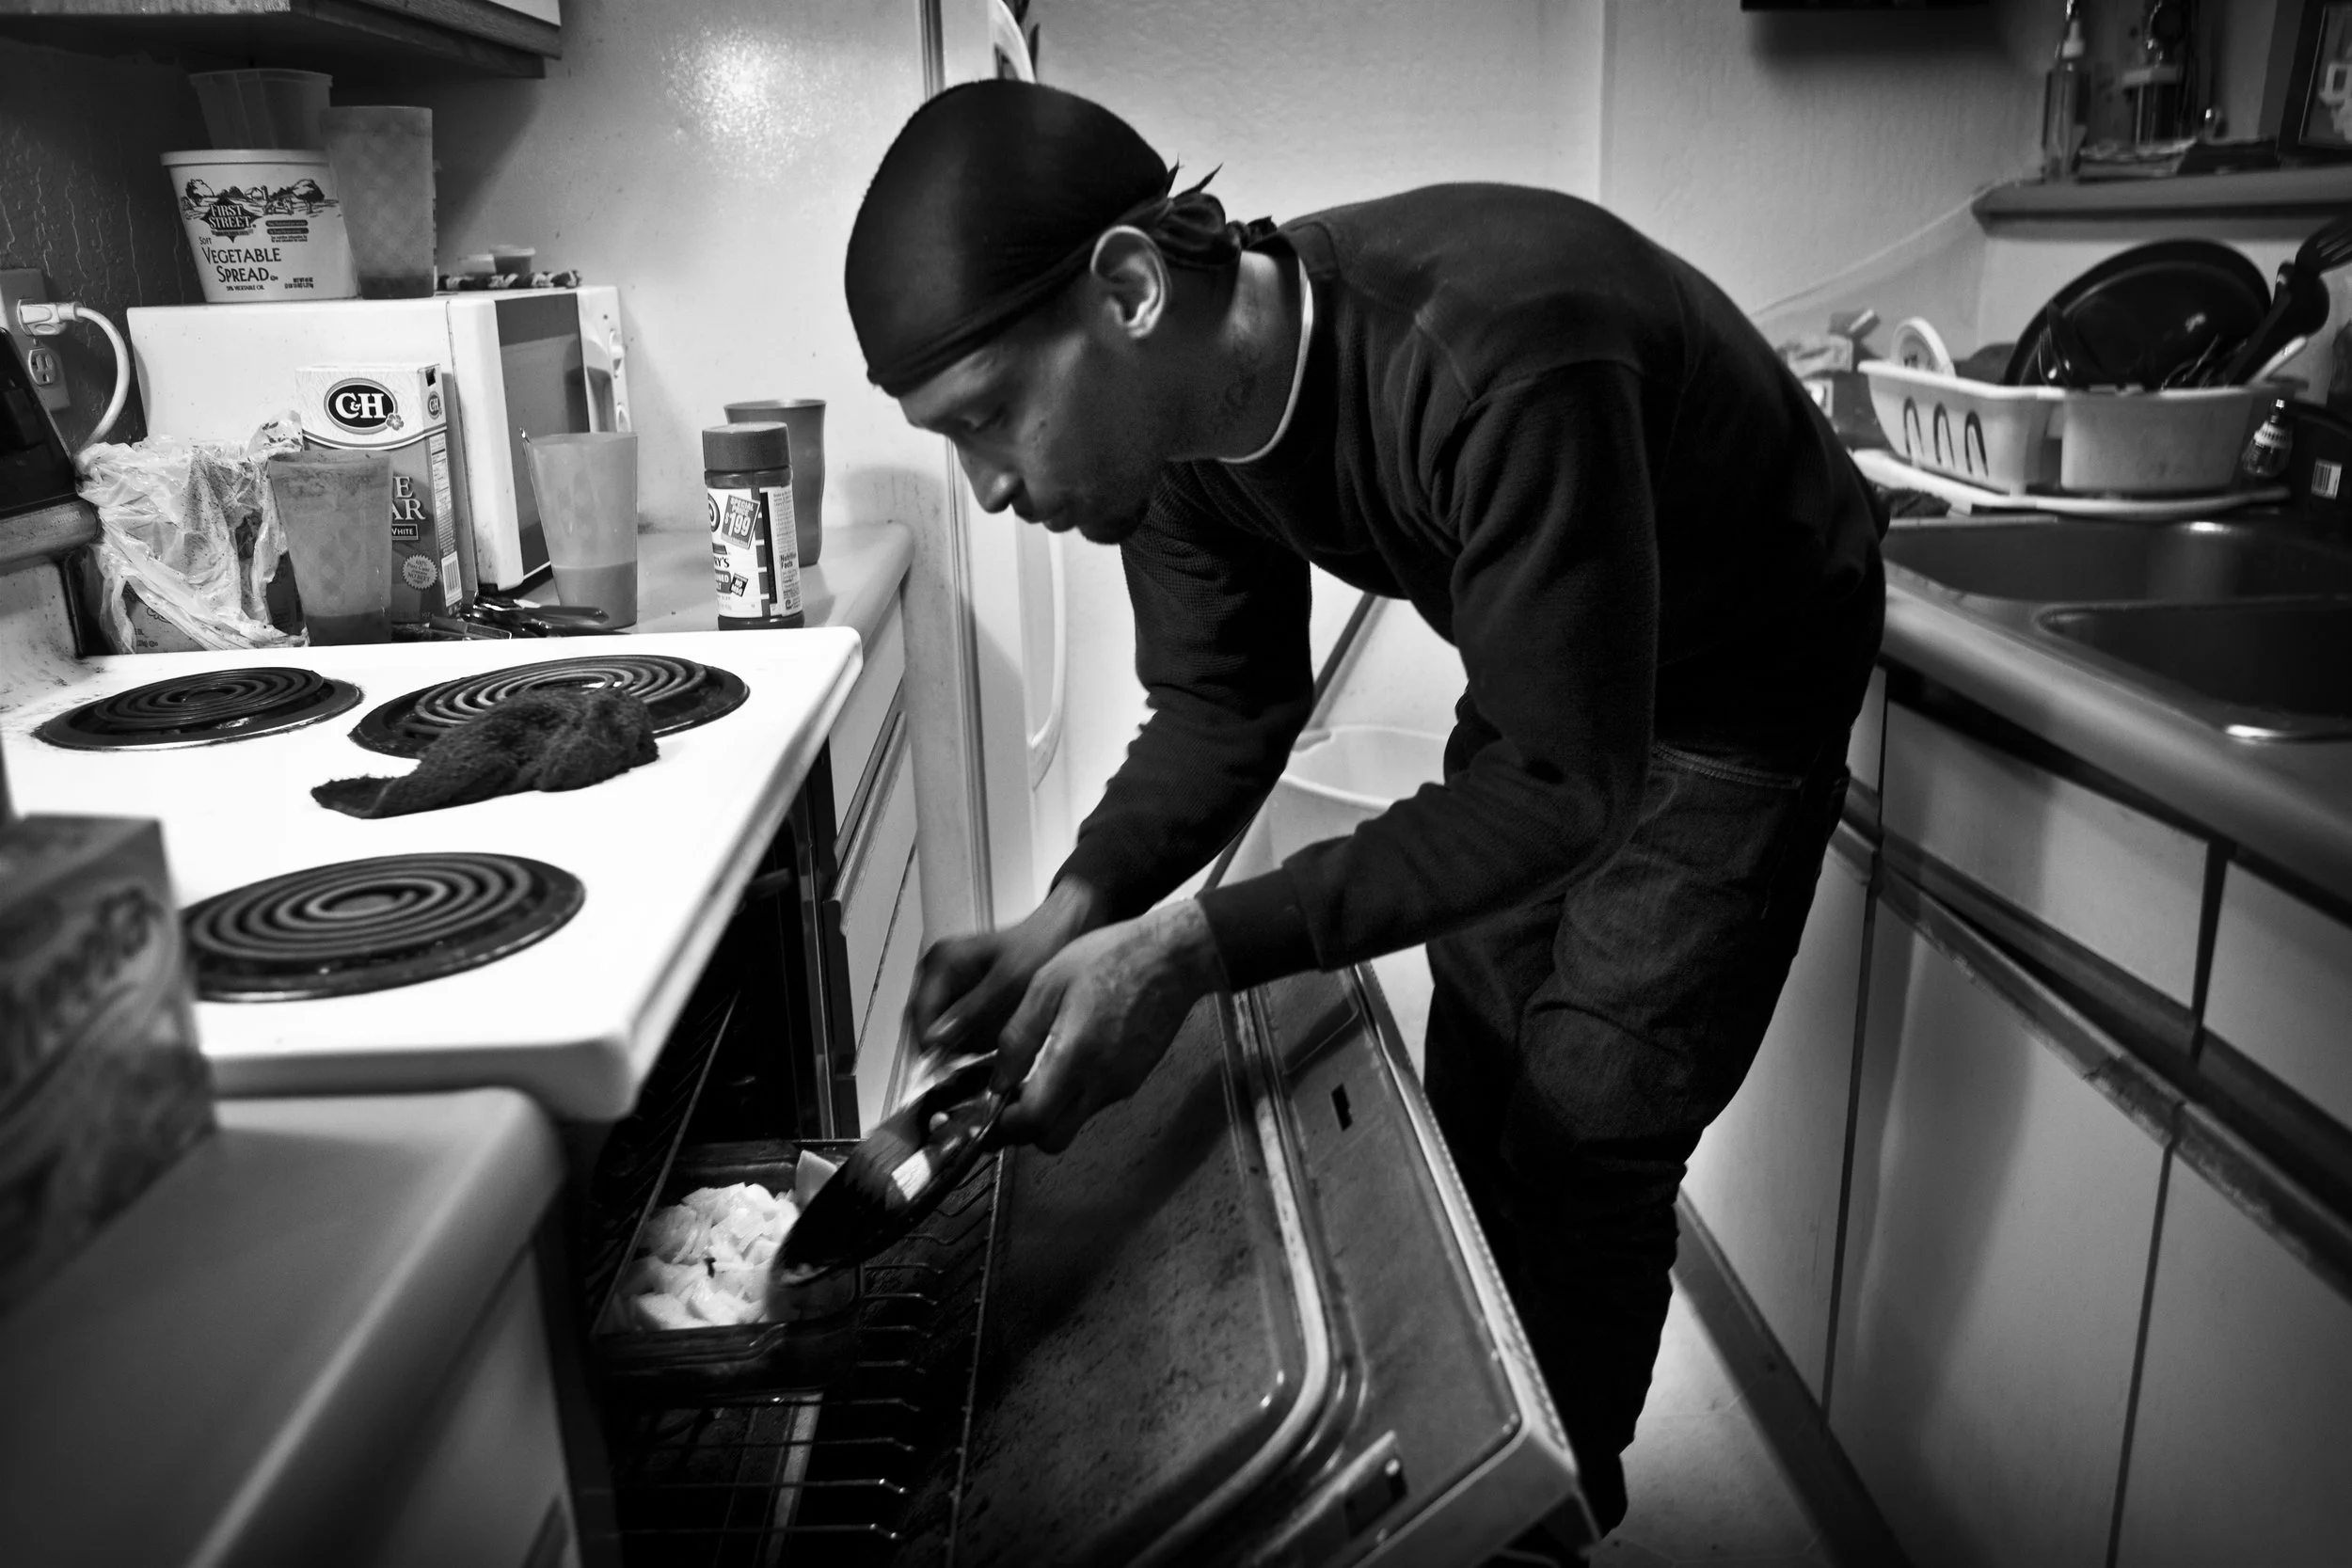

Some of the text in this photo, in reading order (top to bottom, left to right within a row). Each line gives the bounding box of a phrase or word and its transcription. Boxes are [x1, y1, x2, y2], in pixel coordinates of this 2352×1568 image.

[209, 203, 243, 216] FIRST
[208, 215, 252, 229] STREET
[201, 246, 281, 264] VEGETABLE
[216, 265, 269, 283] SPREAD
[335, 392, 387, 420] C&H
[730, 497, 755, 512] SPECIAL
[731, 505, 750, 517] PRICE
